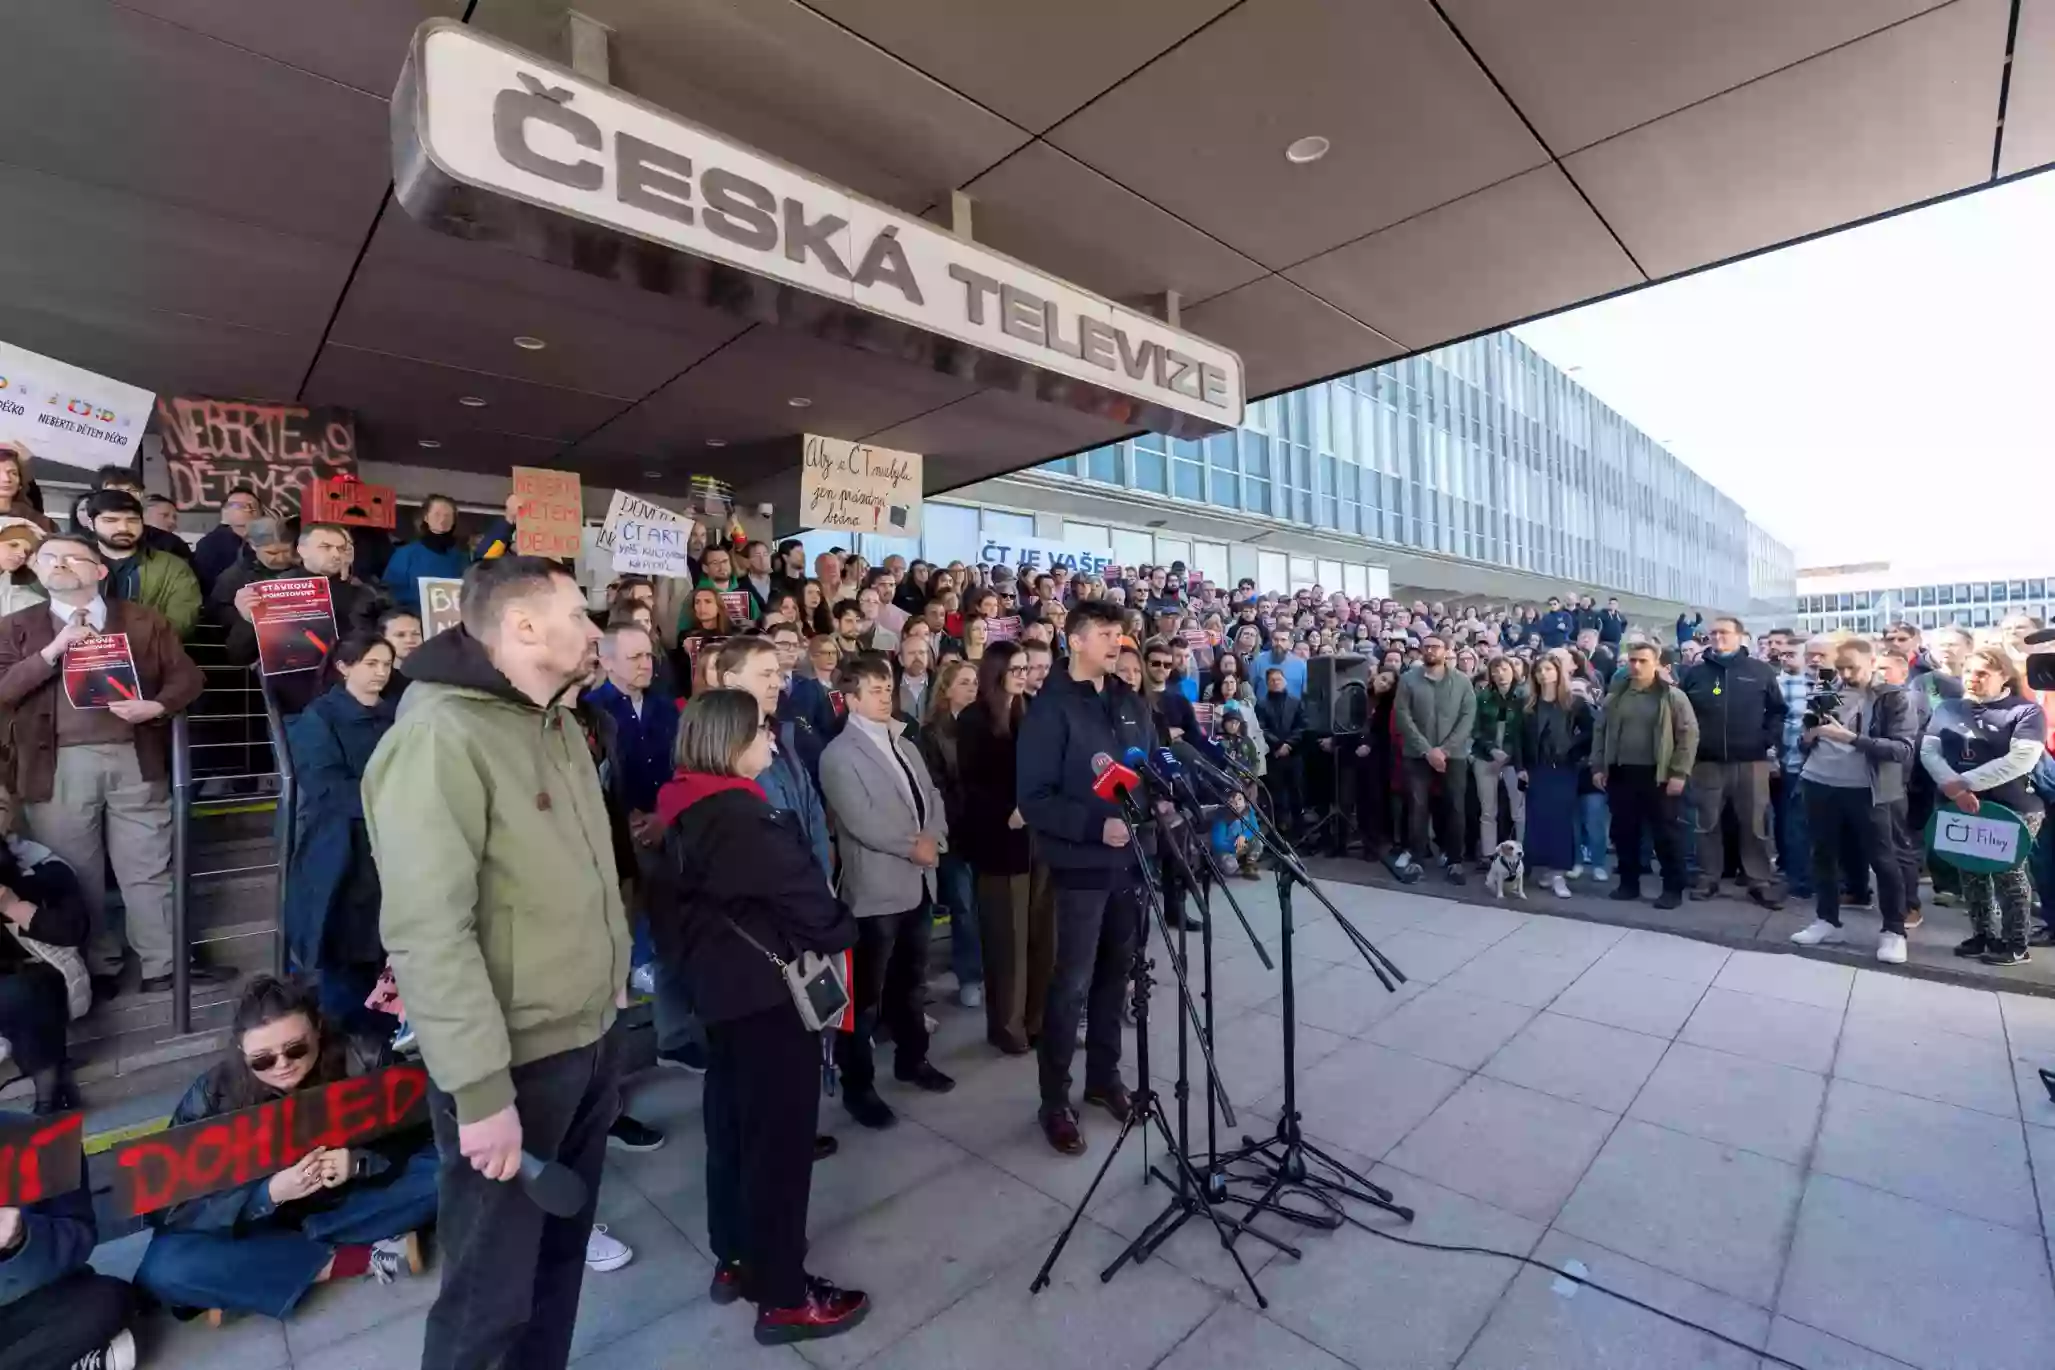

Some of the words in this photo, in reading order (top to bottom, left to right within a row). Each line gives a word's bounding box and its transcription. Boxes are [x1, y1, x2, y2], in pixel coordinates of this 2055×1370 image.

[492, 72, 924, 305] ČESKÁ
[948, 262, 1230, 409] TELEVIZE
[38, 412, 76, 431] NEBERTE
[806, 437, 833, 480] Aby
[811, 485, 836, 511] jen
[624, 521, 645, 541] ČT
[647, 528, 686, 547] ART
[981, 540, 1011, 563] ČT
[1016, 549, 1041, 568] JE
[119, 1066, 428, 1216] DOHLED
